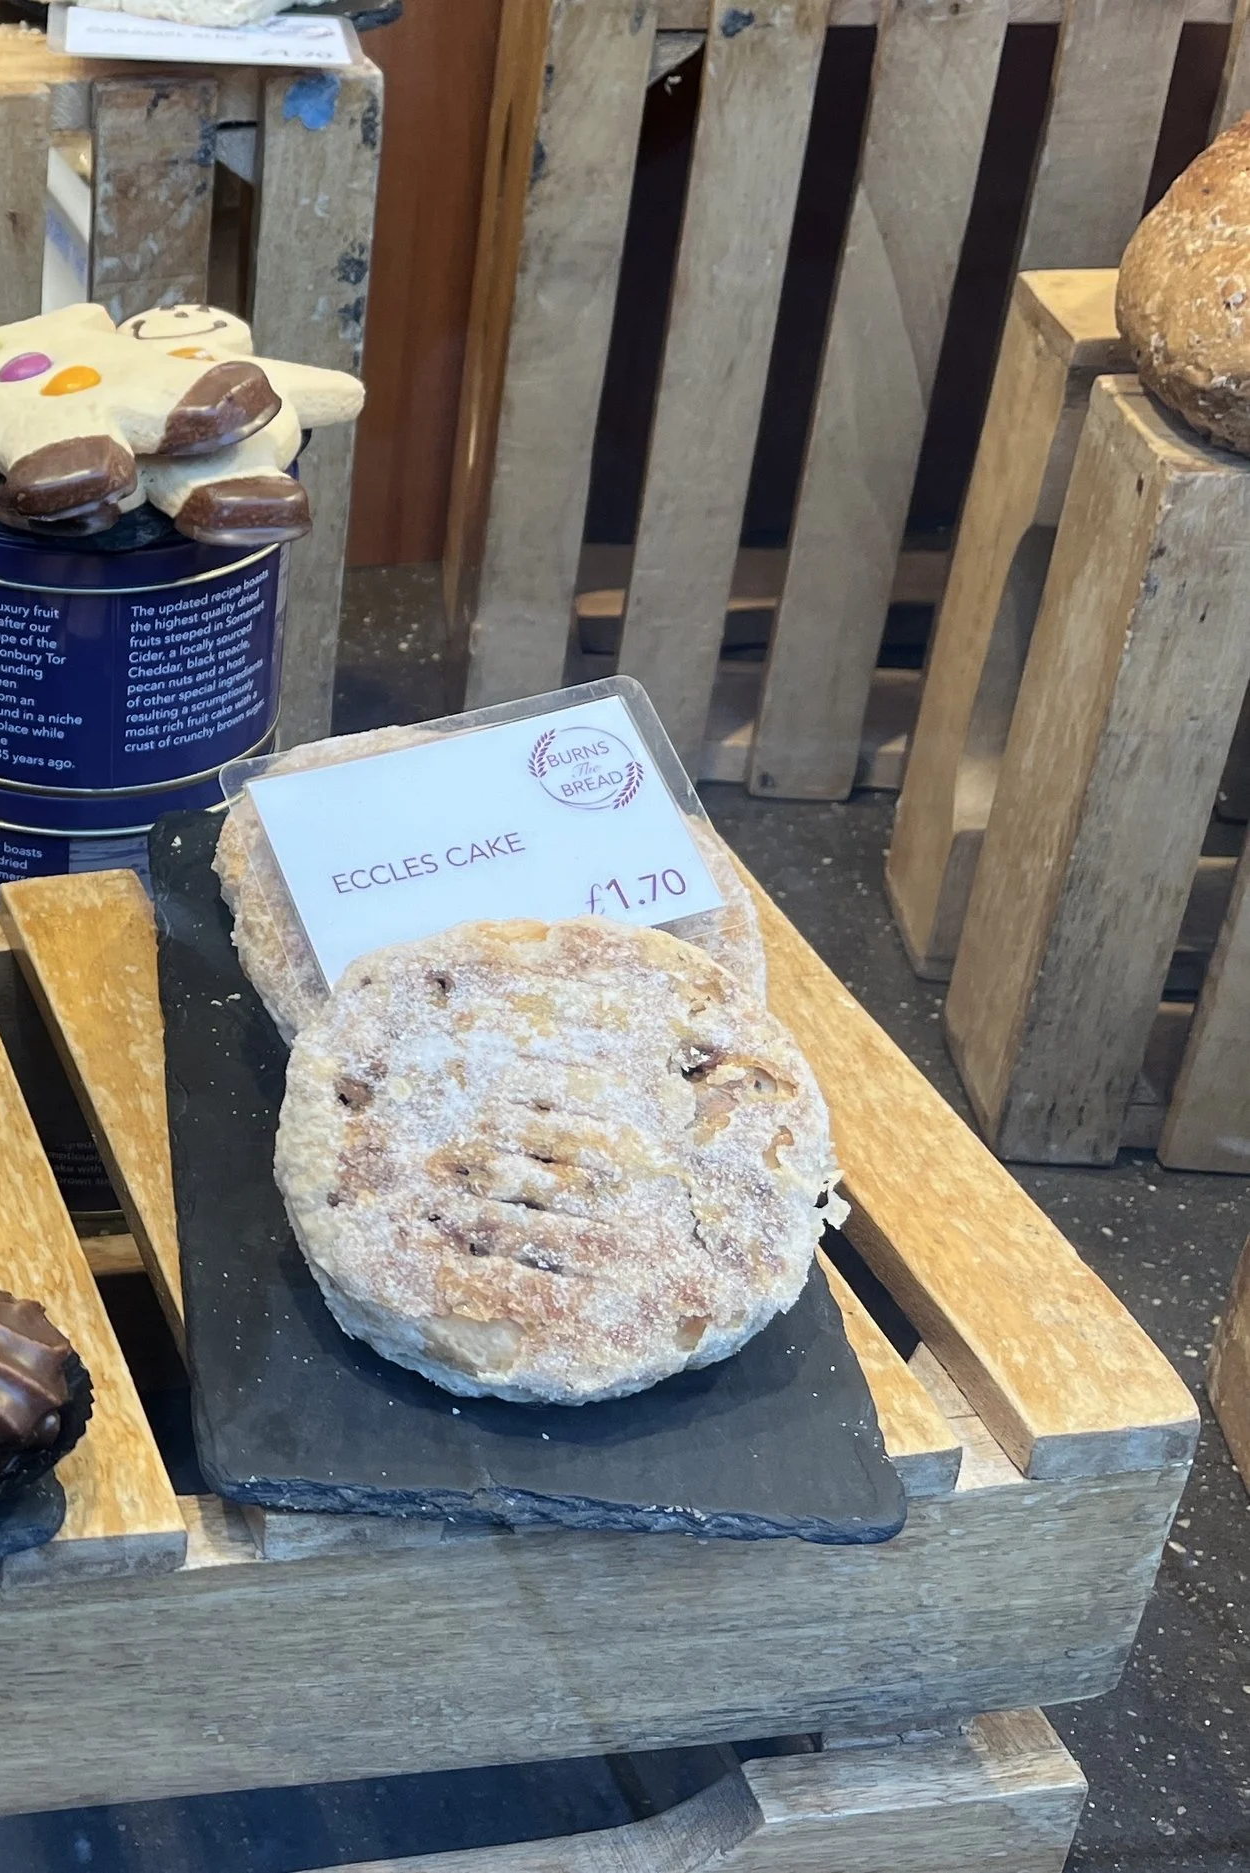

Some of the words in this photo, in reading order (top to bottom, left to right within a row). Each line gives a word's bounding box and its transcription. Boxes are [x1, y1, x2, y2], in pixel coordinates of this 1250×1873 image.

[131, 606, 155, 617] The
[159, 593, 208, 615] updated
[211, 585, 241, 601] recipe
[244, 569, 269, 589] boasts
[34, 605, 60, 619] fruit
[130, 636, 161, 647] fruits
[165, 624, 211, 645] steeped
[214, 622, 223, 631] in
[226, 600, 264, 627] Somerset
[131, 622, 151, 633] the
[155, 613, 198, 631] highest
[201, 601, 235, 620] quality
[238, 587, 260, 607] dried
[30, 622, 51, 633] our
[129, 652, 165, 663] Cider,
[169, 650, 176, 658] a
[180, 638, 214, 656] locally
[216, 620, 252, 645] sourced
[20, 636, 33, 646] of
[37, 638, 57, 649] the
[46, 653, 67, 665] Tor
[128, 663, 183, 679] Cheddar,
[187, 654, 215, 669] black
[127, 681, 165, 695] pecan
[169, 675, 193, 688] nuts
[196, 668, 215, 681] and
[218, 665, 224, 674] a
[227, 655, 245, 671] host
[127, 698, 140, 708] of
[143, 694, 175, 706] other
[179, 680, 216, 701] special
[218, 658, 263, 688] ingredients
[20, 697, 35, 706] an
[125, 725, 159, 737] moist
[162, 720, 184, 733] rich
[187, 712, 209, 728] fruit
[211, 704, 232, 720] cake
[235, 694, 252, 710] with
[253, 690, 257, 699] a
[126, 708, 178, 723] resulting
[182, 705, 188, 714] a
[191, 679, 254, 711] scrumptiously
[23, 711, 34, 720] in
[38, 714, 44, 722] a
[49, 714, 83, 725] niche
[33, 727, 64, 739] while
[125, 741, 155, 752] crust
[158, 736, 170, 748] of
[173, 726, 215, 745] crunchy
[217, 713, 244, 732] brown
[13, 754, 44, 766] years
[48, 758, 75, 770] ago.
[547, 740, 611, 768] BURNS
[571, 761, 601, 778] The
[560, 770, 624, 798] BREAD
[4, 842, 42, 858] boasts
[332, 853, 439, 894] ECCLES
[446, 832, 526, 868] CAKE
[584, 868, 687, 916] £1.70
